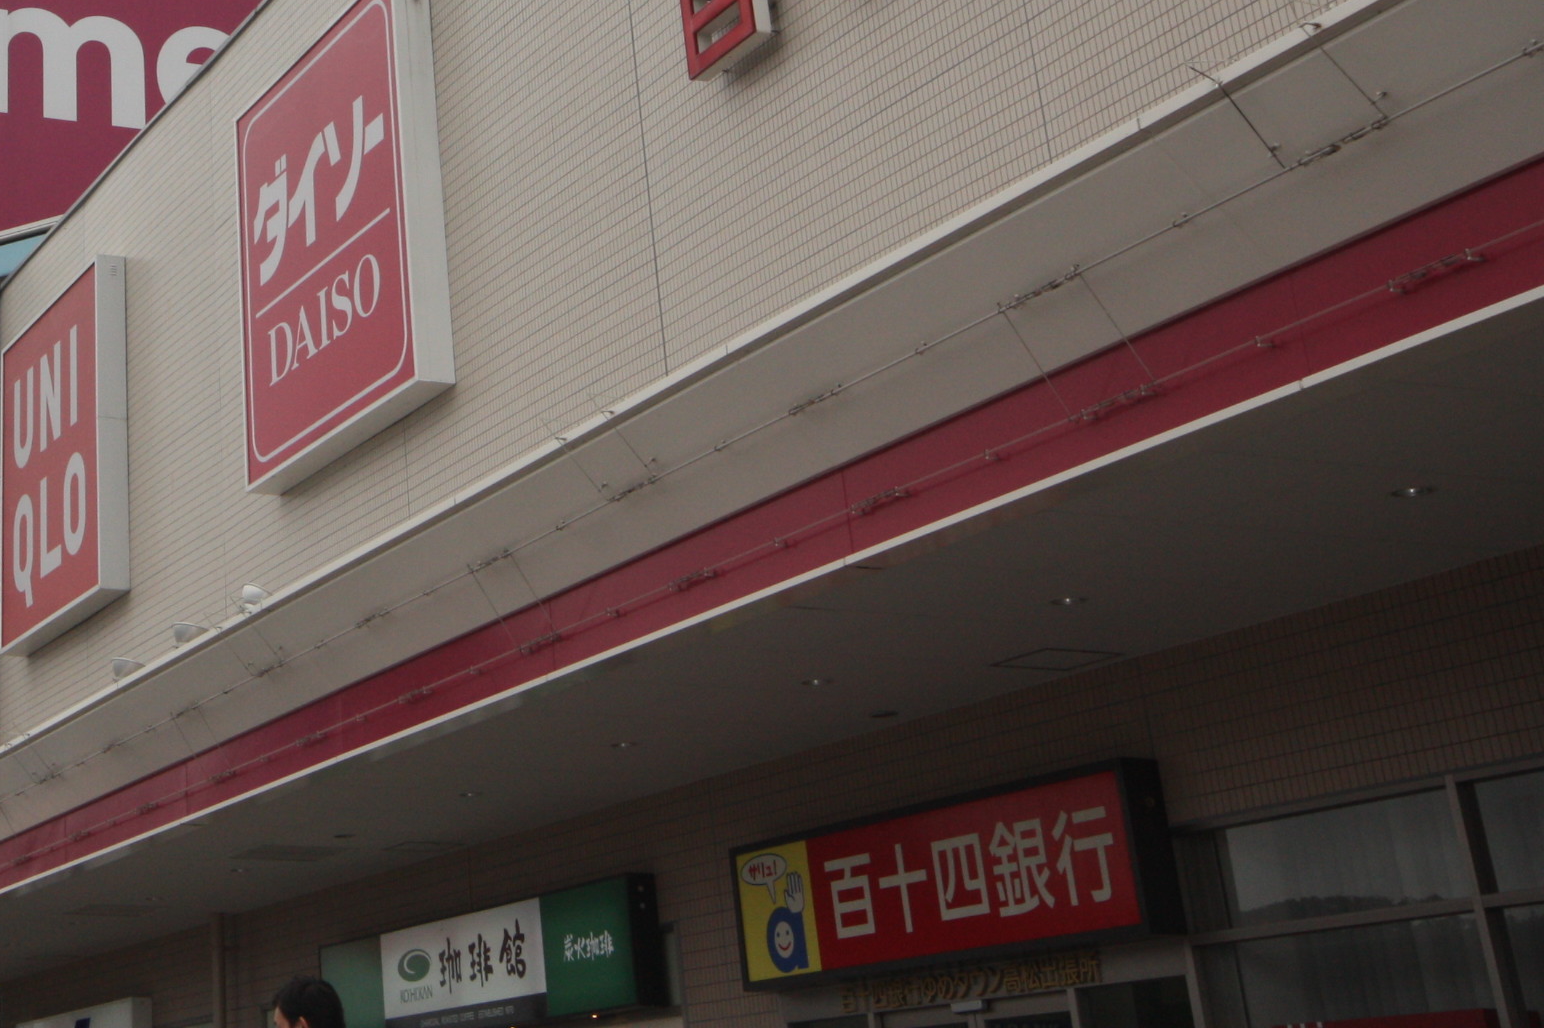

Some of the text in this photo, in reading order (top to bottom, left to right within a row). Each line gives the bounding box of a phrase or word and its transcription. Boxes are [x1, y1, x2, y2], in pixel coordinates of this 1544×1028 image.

[254, 94, 385, 287] ダイソー
[267, 253, 382, 386] DAISO
[12, 323, 78, 470] UNI
[12, 451, 87, 609] QLO
[823, 805, 1114, 940] 百十四銀行
[438, 918, 527, 994] 珈琲館
[563, 929, 615, 962] 炭火珈琲
